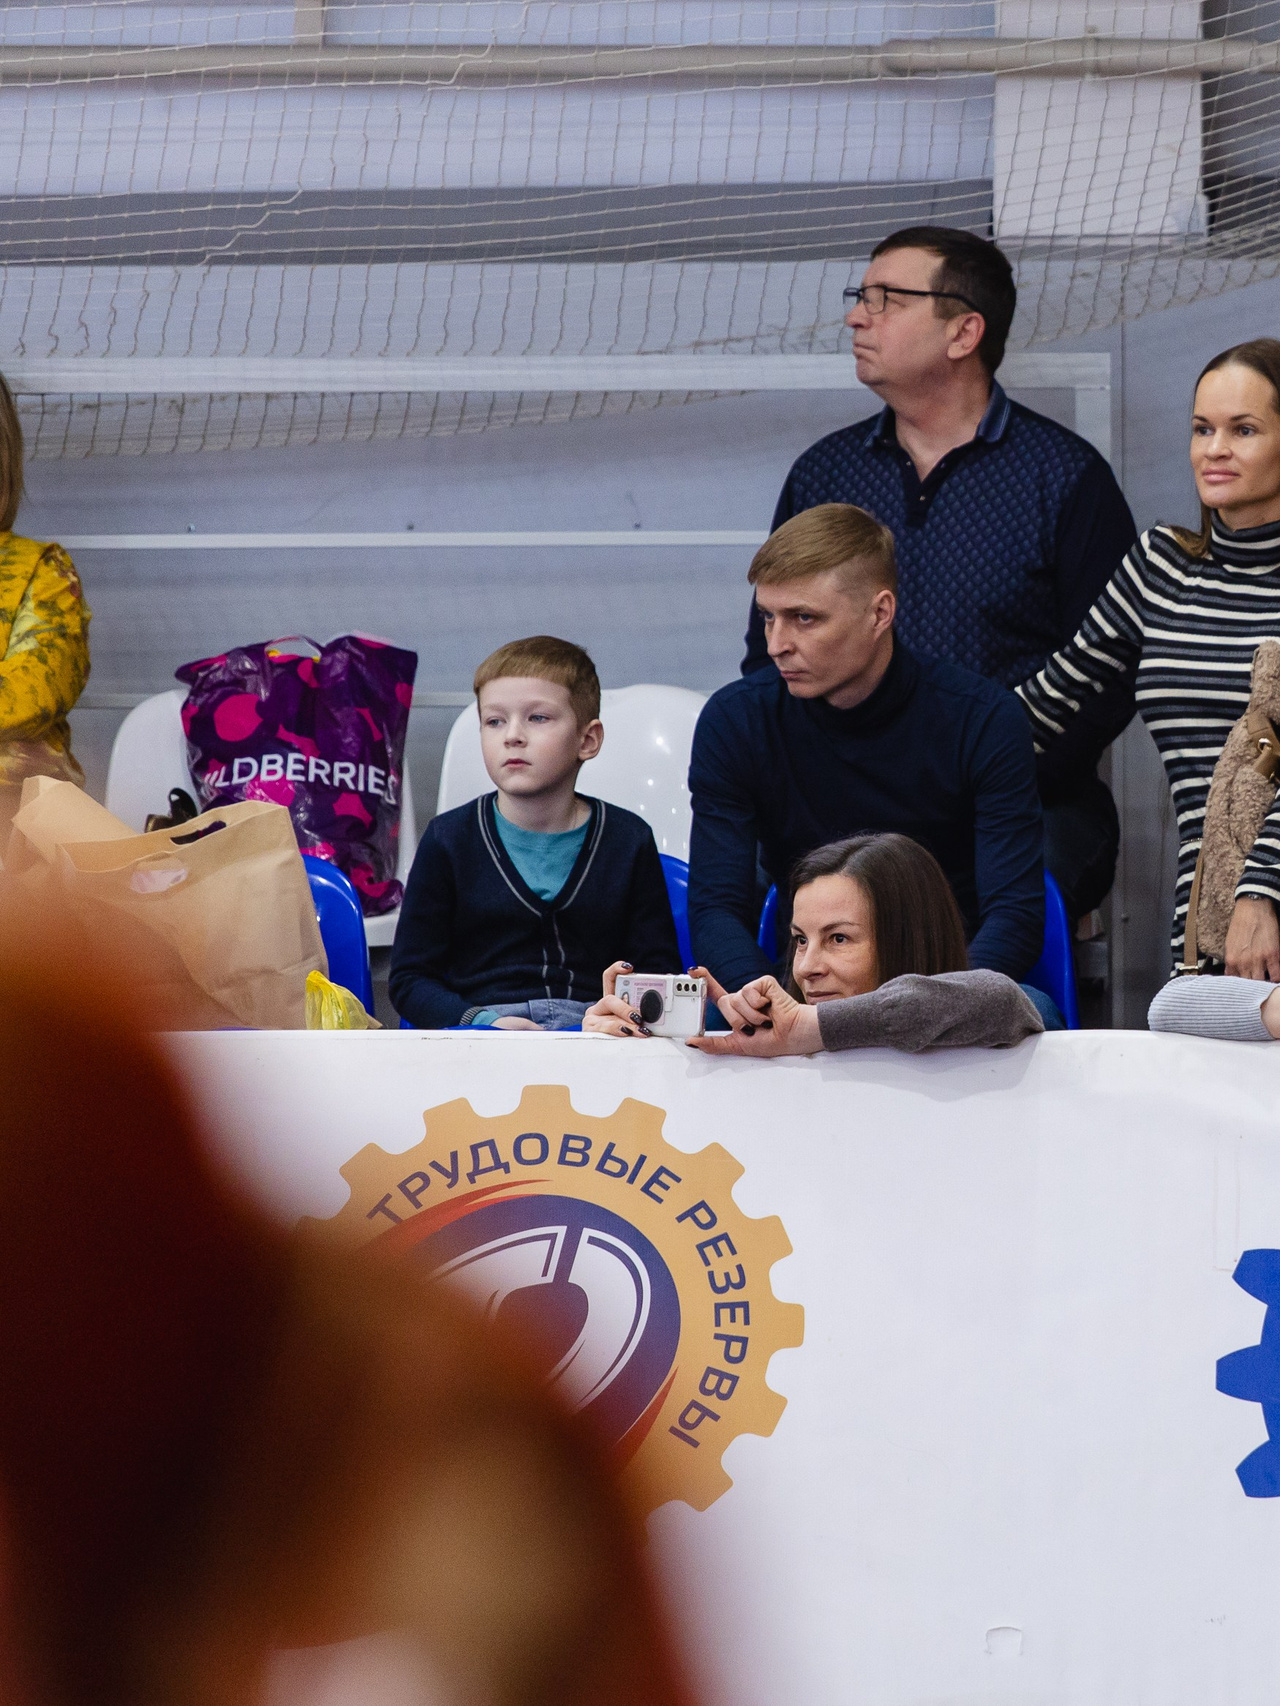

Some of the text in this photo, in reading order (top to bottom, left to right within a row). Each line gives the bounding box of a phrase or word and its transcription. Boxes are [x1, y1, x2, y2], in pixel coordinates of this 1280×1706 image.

[203, 752, 398, 805] ILDBERRIES
[365, 1131, 751, 1449] ТРУДОВЫЕ РЕЗЕРВЫ
